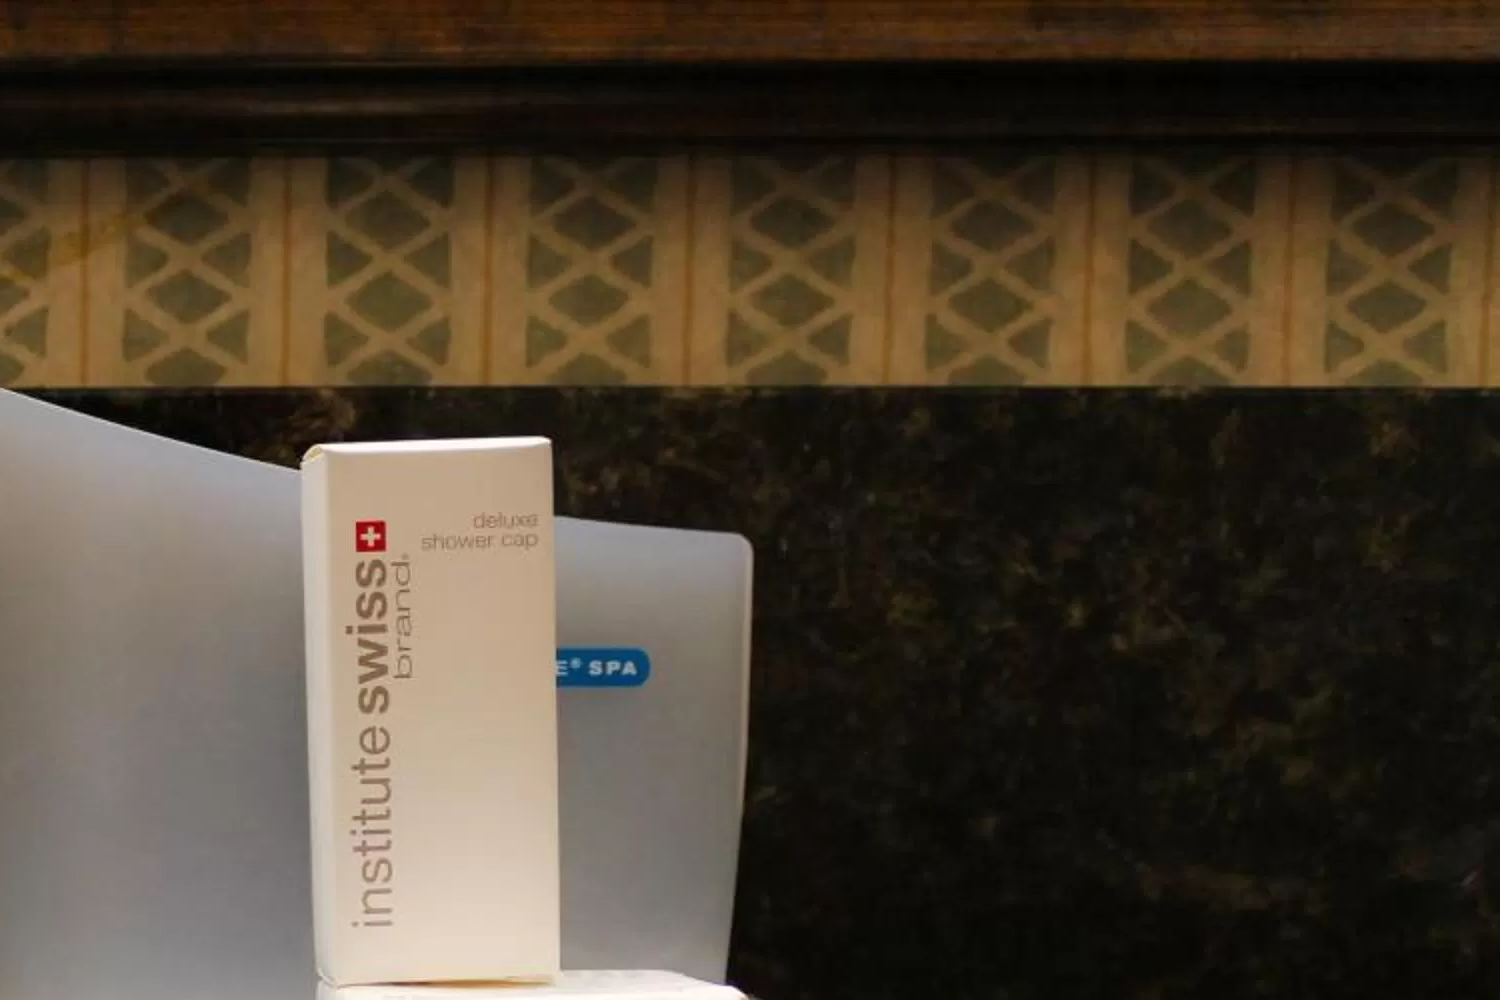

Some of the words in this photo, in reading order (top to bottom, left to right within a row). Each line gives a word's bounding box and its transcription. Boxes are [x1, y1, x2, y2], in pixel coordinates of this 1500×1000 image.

[472, 511, 540, 530] deluxe
[421, 532, 496, 551] shower
[500, 532, 540, 550] cap
[345, 558, 391, 714] swiss
[587, 659, 639, 677] SPA
[349, 725, 393, 929] institute
